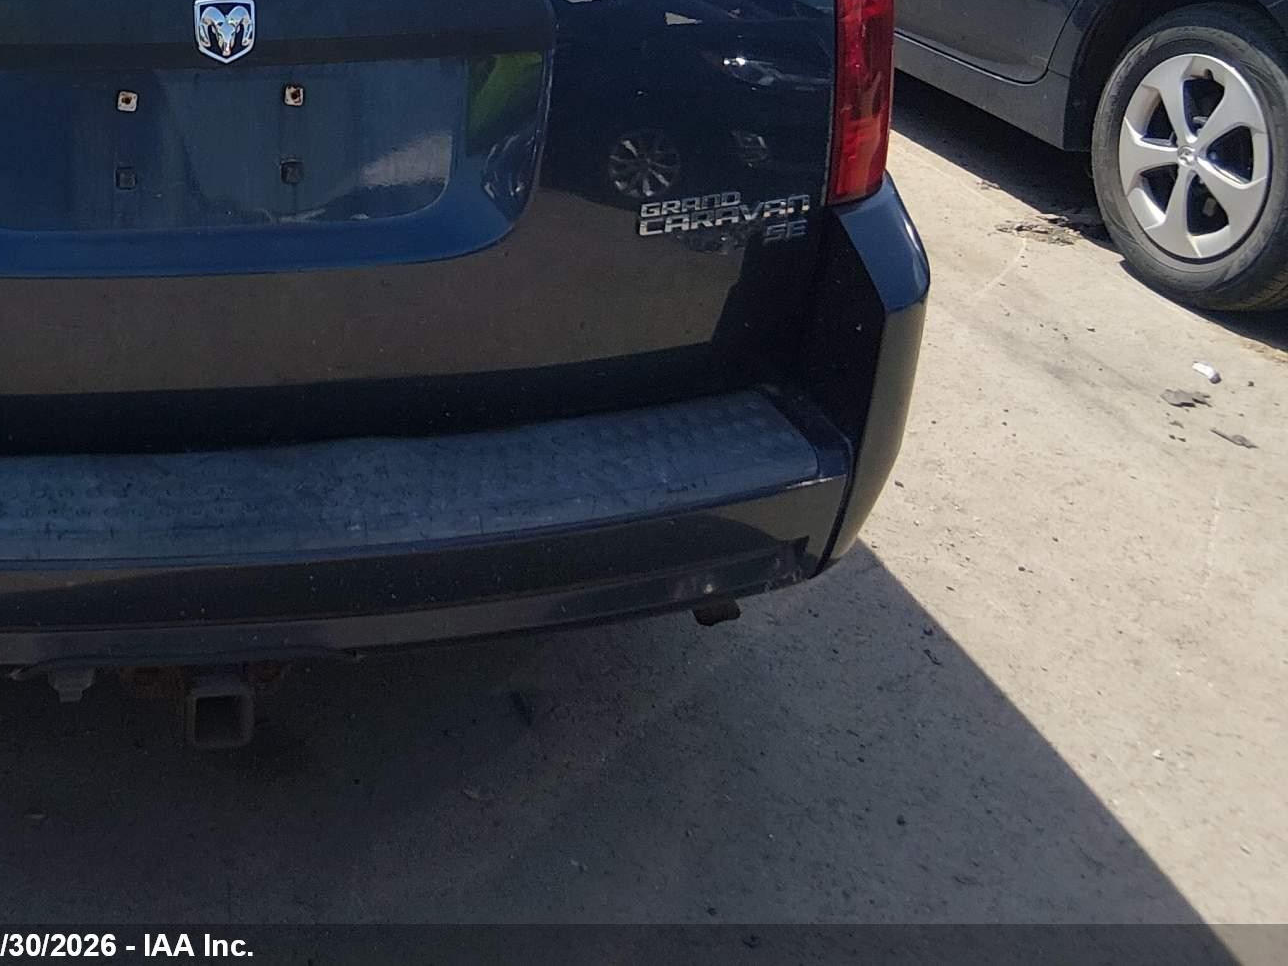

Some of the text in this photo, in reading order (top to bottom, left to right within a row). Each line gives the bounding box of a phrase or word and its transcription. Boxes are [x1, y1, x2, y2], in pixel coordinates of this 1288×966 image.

[639, 194, 811, 236] CARAVAN
[640, 191, 742, 218] GRAND
[763, 218, 808, 242] SE
